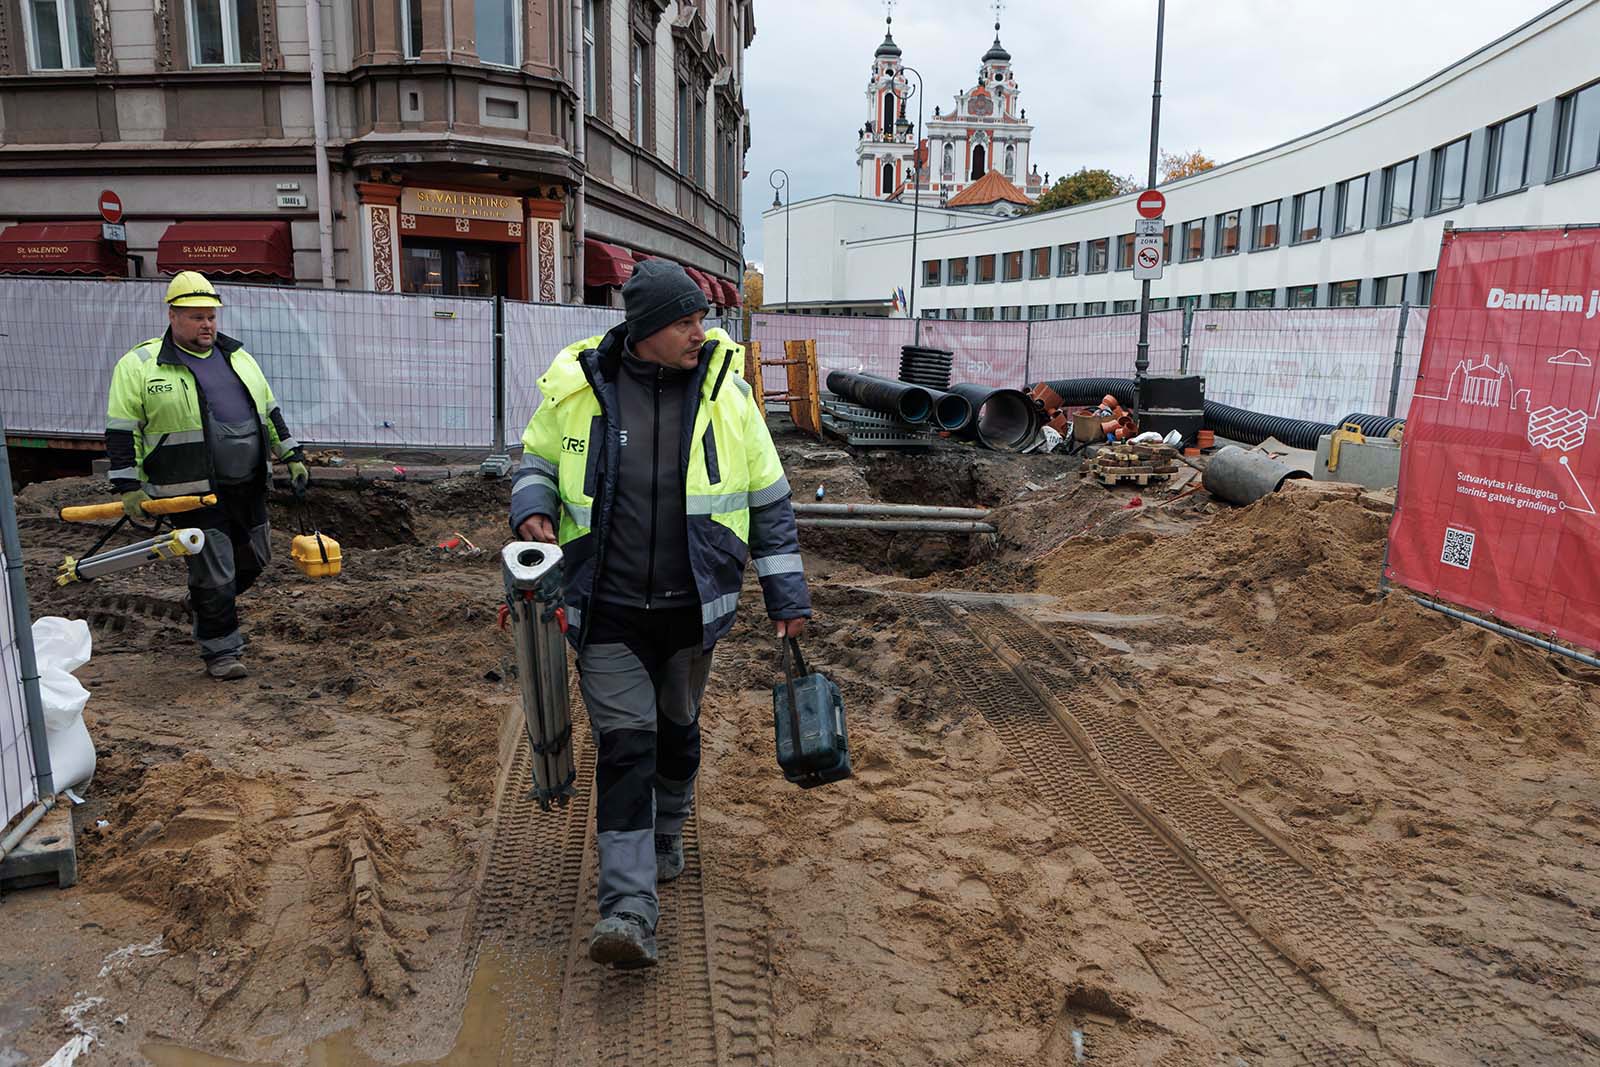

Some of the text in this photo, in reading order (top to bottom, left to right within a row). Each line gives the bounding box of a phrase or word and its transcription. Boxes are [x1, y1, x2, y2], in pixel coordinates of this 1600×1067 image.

[436, 193, 510, 208] VALENTINO
[27, 246, 69, 254] VALENTINO
[193, 245, 237, 254] VALENTINO
[1486, 288, 1600, 319] Darniam j
[146, 384, 173, 394] KRS
[1457, 471, 1506, 488] Sutvarkytas
[1506, 481, 1514, 491] ir
[1456, 484, 1557, 515] istorinis gatvės grindinys
